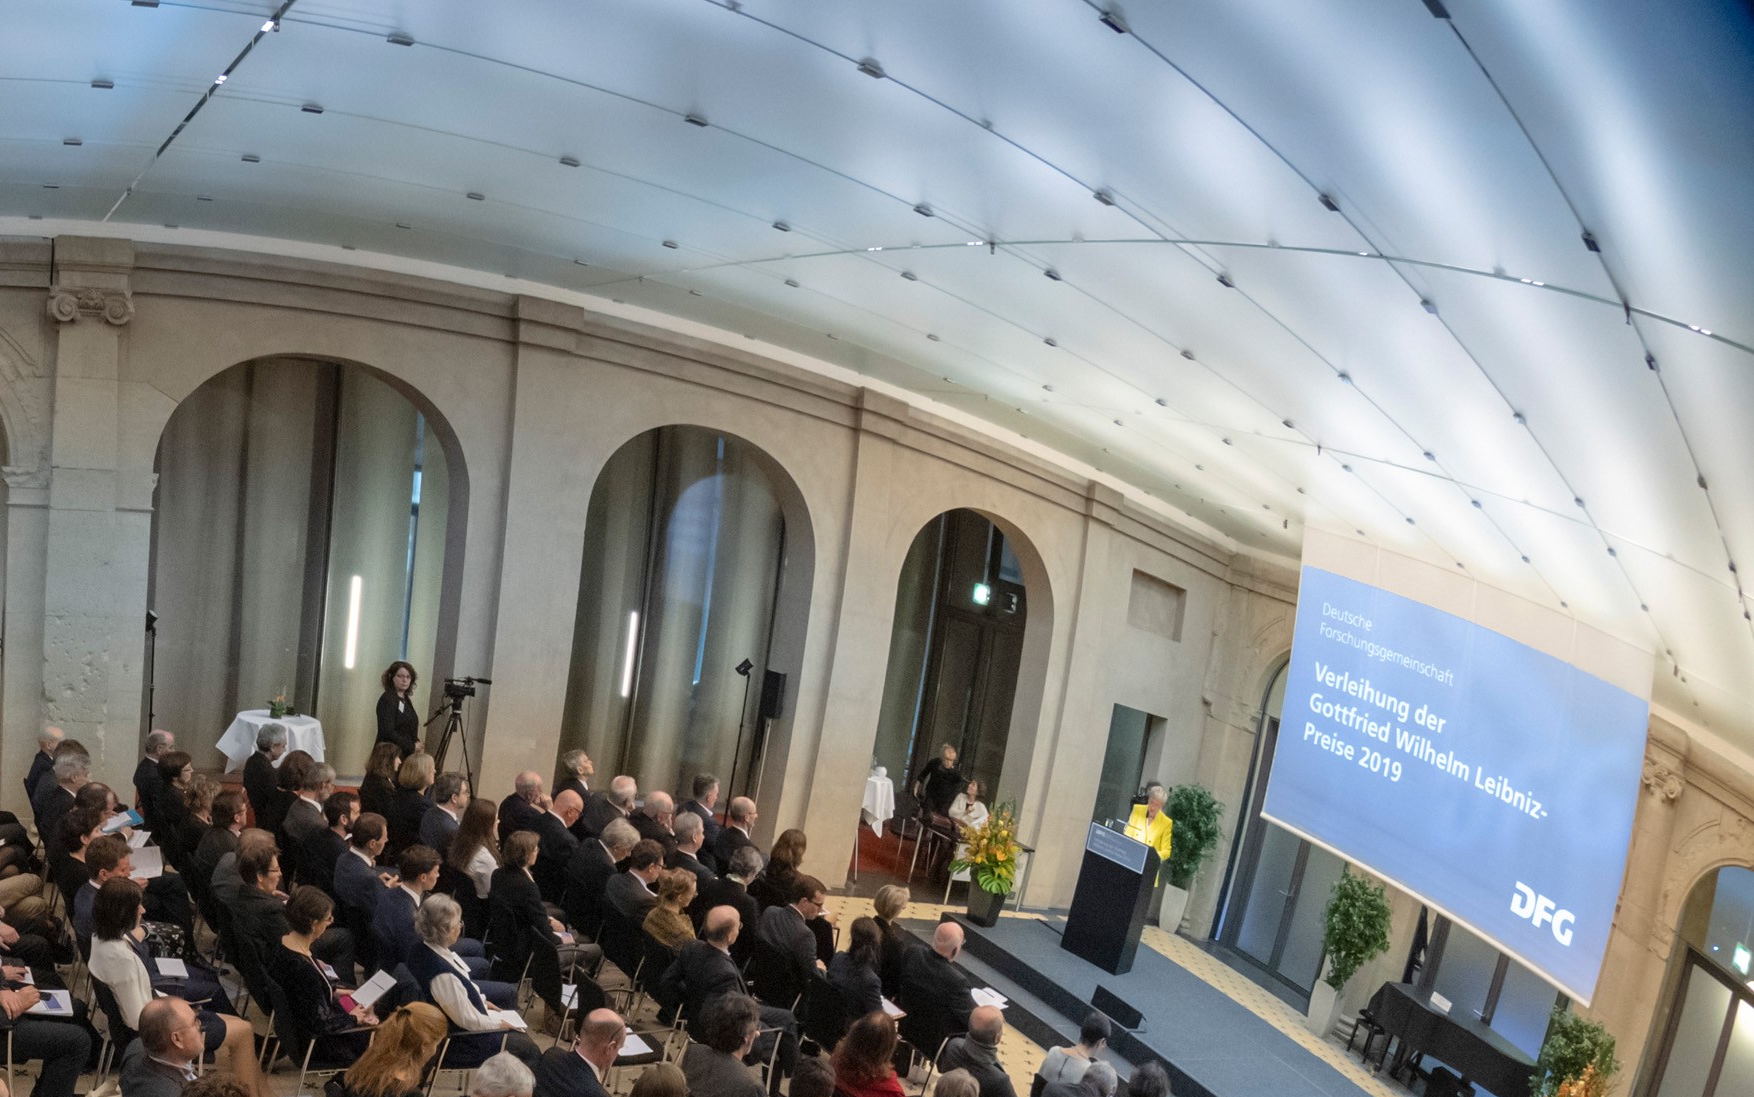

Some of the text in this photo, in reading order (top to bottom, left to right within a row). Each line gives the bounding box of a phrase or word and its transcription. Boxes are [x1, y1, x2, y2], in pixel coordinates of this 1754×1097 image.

[1322, 602, 1373, 632] Deutsche
[1320, 622, 1455, 687] Forschungsgemeinschaft
[1315, 662, 1447, 734] Verleihung der
[1303, 722, 1403, 782] Preise 2019
[1309, 693, 1549, 819] Gottfried Wilhelm Leibniz-
[1509, 880, 1576, 947] DFG
